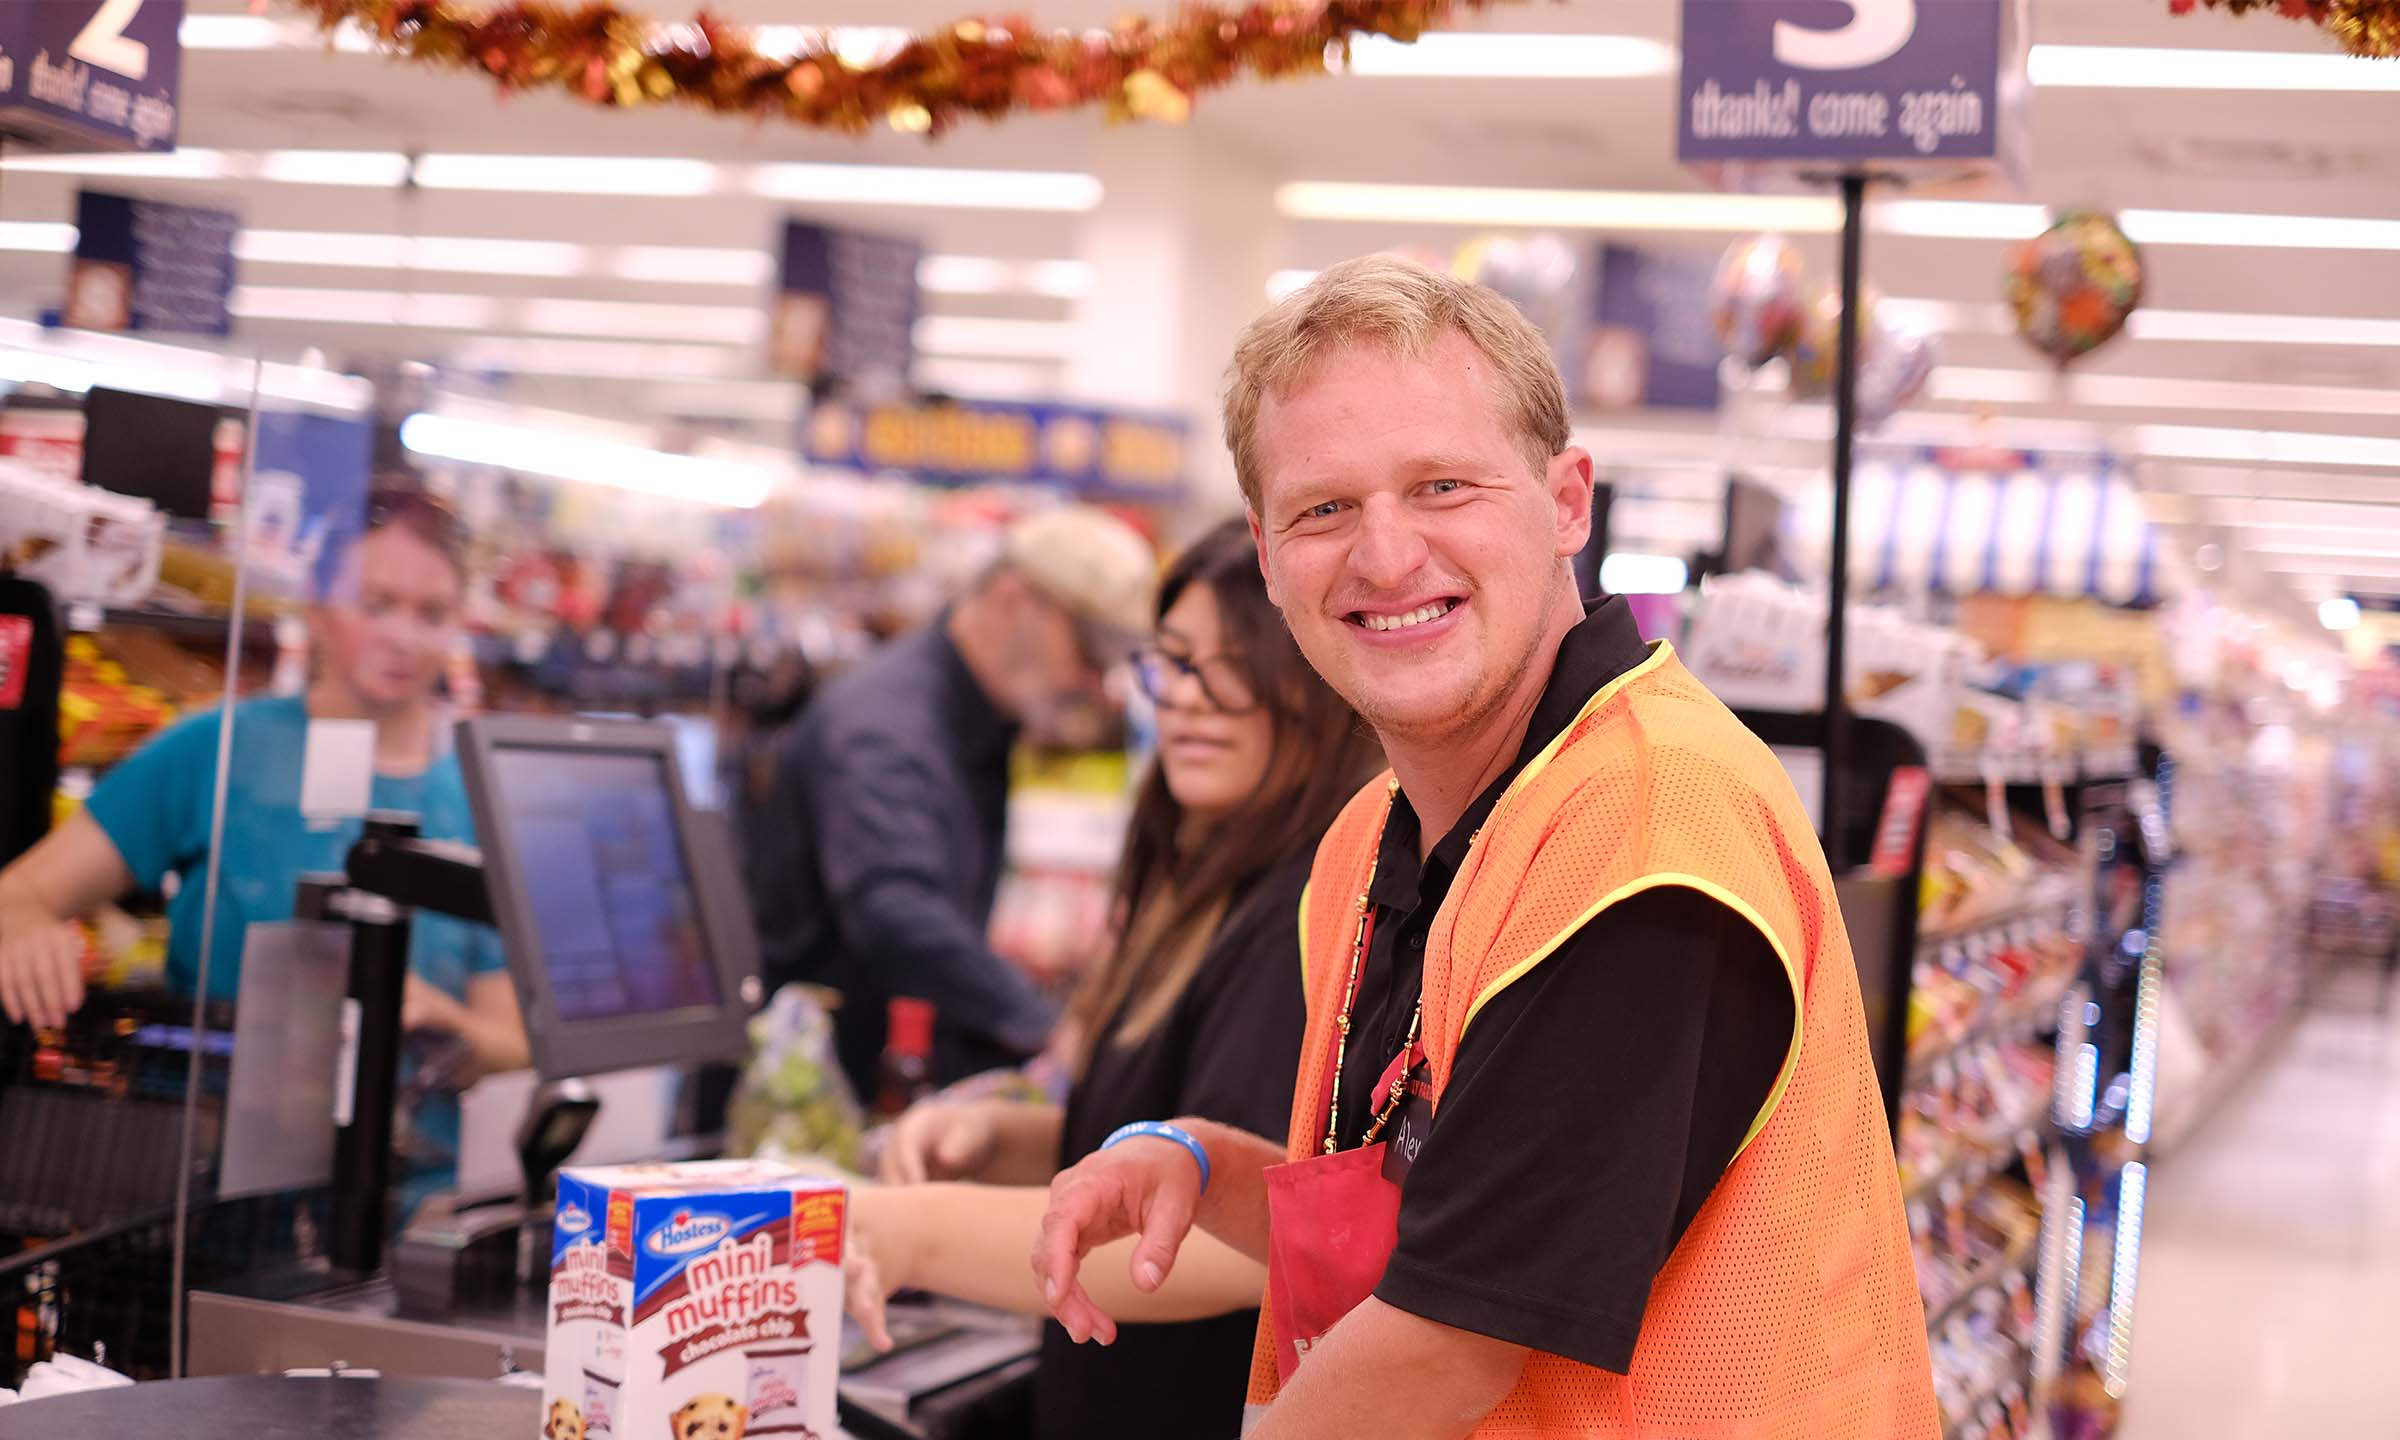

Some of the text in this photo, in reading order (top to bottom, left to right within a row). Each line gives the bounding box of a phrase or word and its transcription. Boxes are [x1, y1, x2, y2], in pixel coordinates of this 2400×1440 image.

[1692, 73, 1982, 155] thanks! come again
[660, 1221, 723, 1249] Hostess
[692, 1239, 767, 1291] mini
[667, 1279, 798, 1336] muffins
[680, 1315, 796, 1364] chocolate chip
